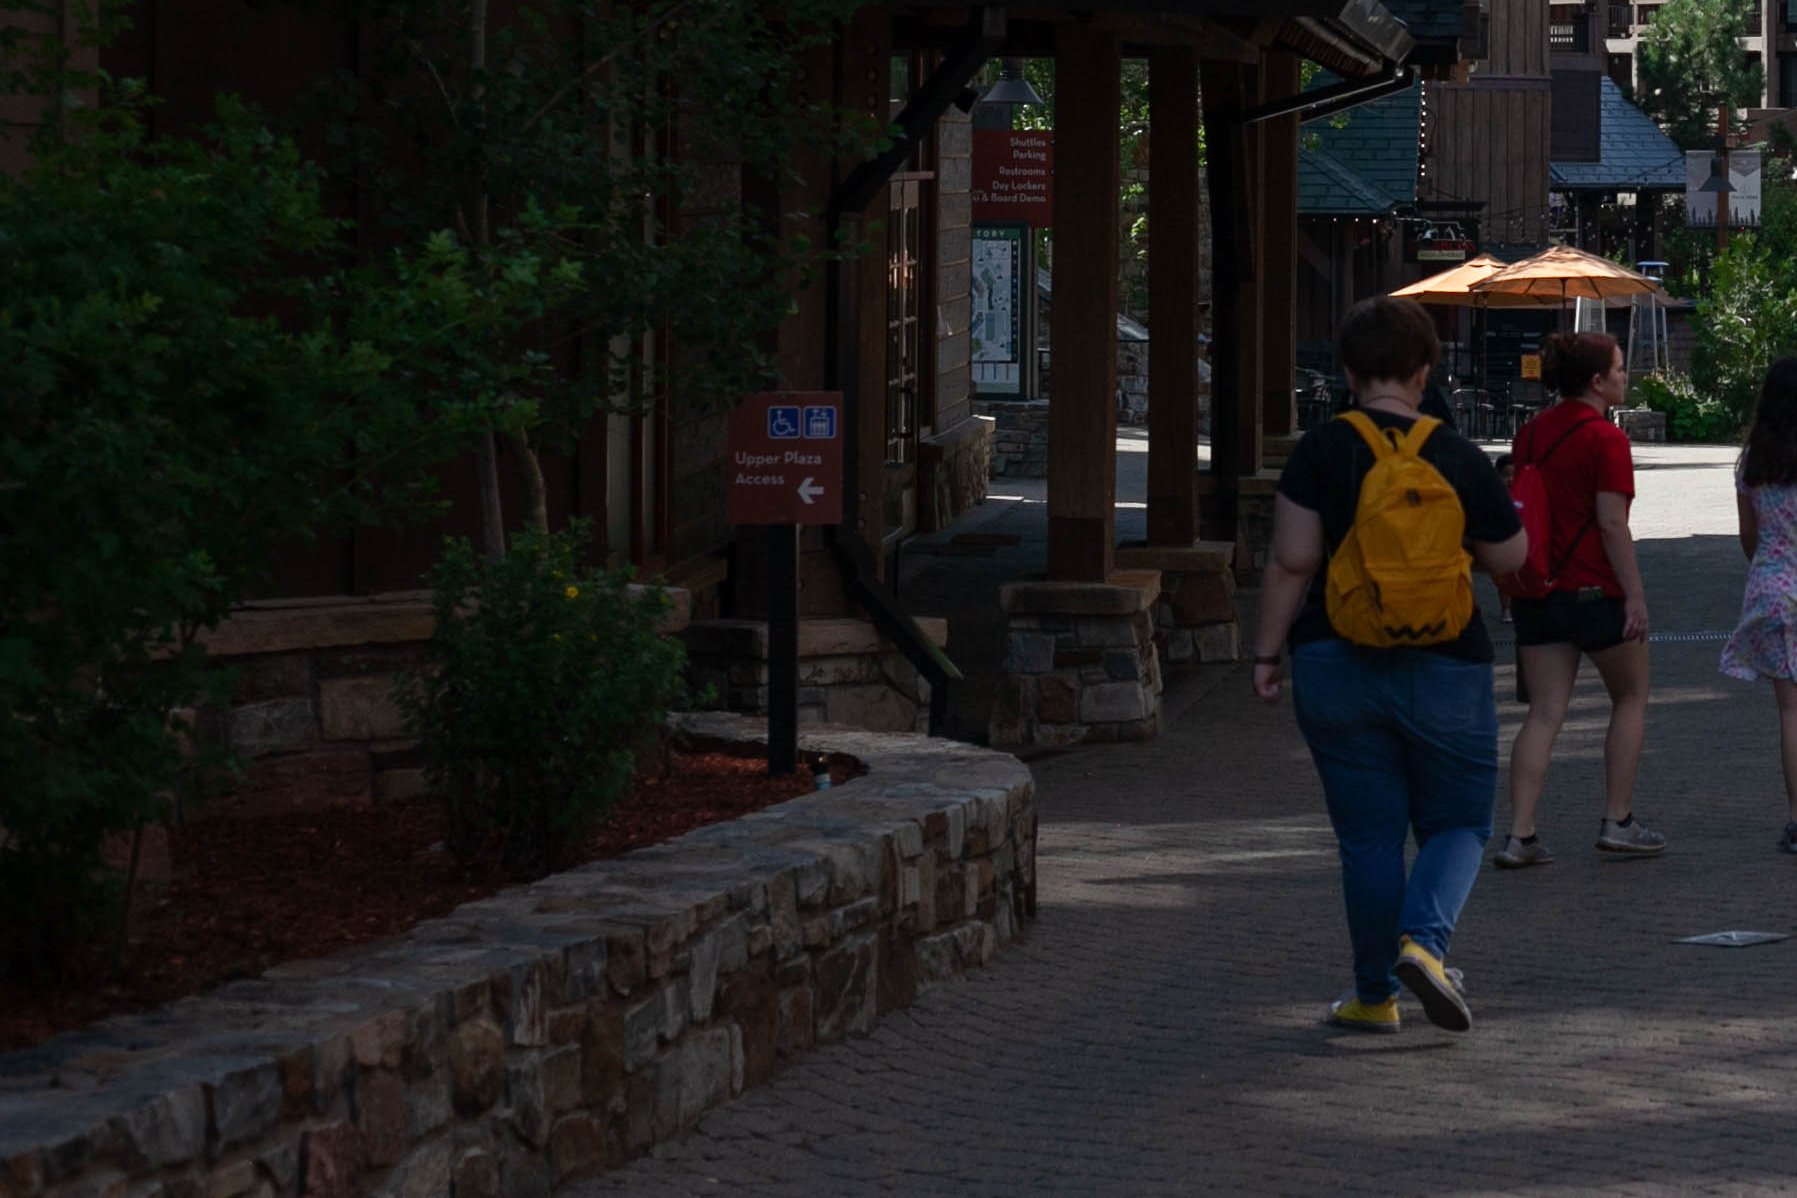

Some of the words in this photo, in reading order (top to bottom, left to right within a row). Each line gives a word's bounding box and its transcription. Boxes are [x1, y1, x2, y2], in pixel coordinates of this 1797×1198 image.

[1010, 137, 1046, 147] Shuttles
[1013, 149, 1047, 162] Parking
[1000, 166, 1046, 176] Restrooms
[992, 180, 1009, 192] Day
[1011, 180, 1046, 191] Lockers
[991, 192, 1018, 202] Board
[1020, 193, 1047, 202] Demo
[735, 451, 781, 468] Upper
[784, 450, 822, 465] Plaza
[735, 473, 784, 485] Access
